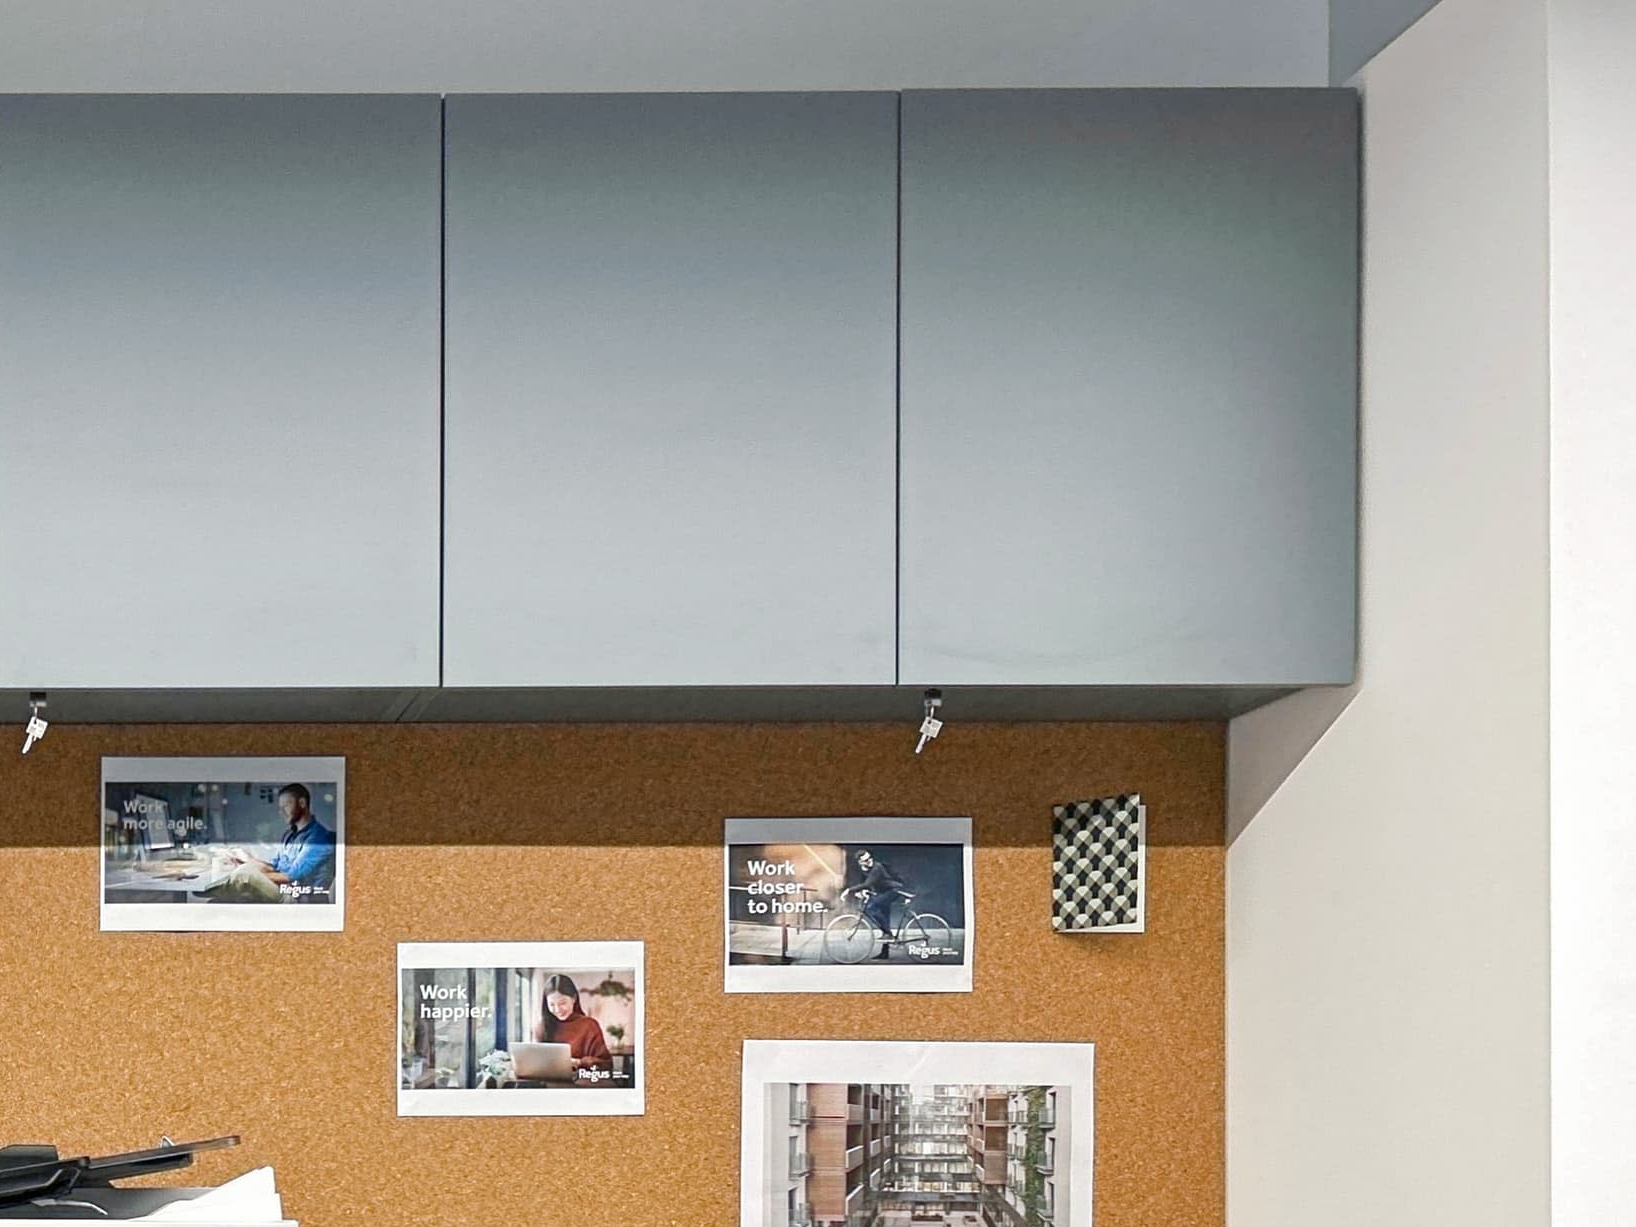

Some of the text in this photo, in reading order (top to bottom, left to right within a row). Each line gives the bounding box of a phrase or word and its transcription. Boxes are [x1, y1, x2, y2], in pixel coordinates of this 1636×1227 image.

[124, 800, 163, 814] Work
[123, 816, 208, 835] more agile.
[747, 860, 795, 876] Work
[279, 882, 312, 898] Regus
[747, 880, 805, 895] closer
[747, 899, 828, 914] to home.
[908, 943, 941, 959] Regus
[419, 984, 468, 1000] Work
[420, 1003, 492, 1022] happier.
[578, 1067, 610, 1083] Regus
